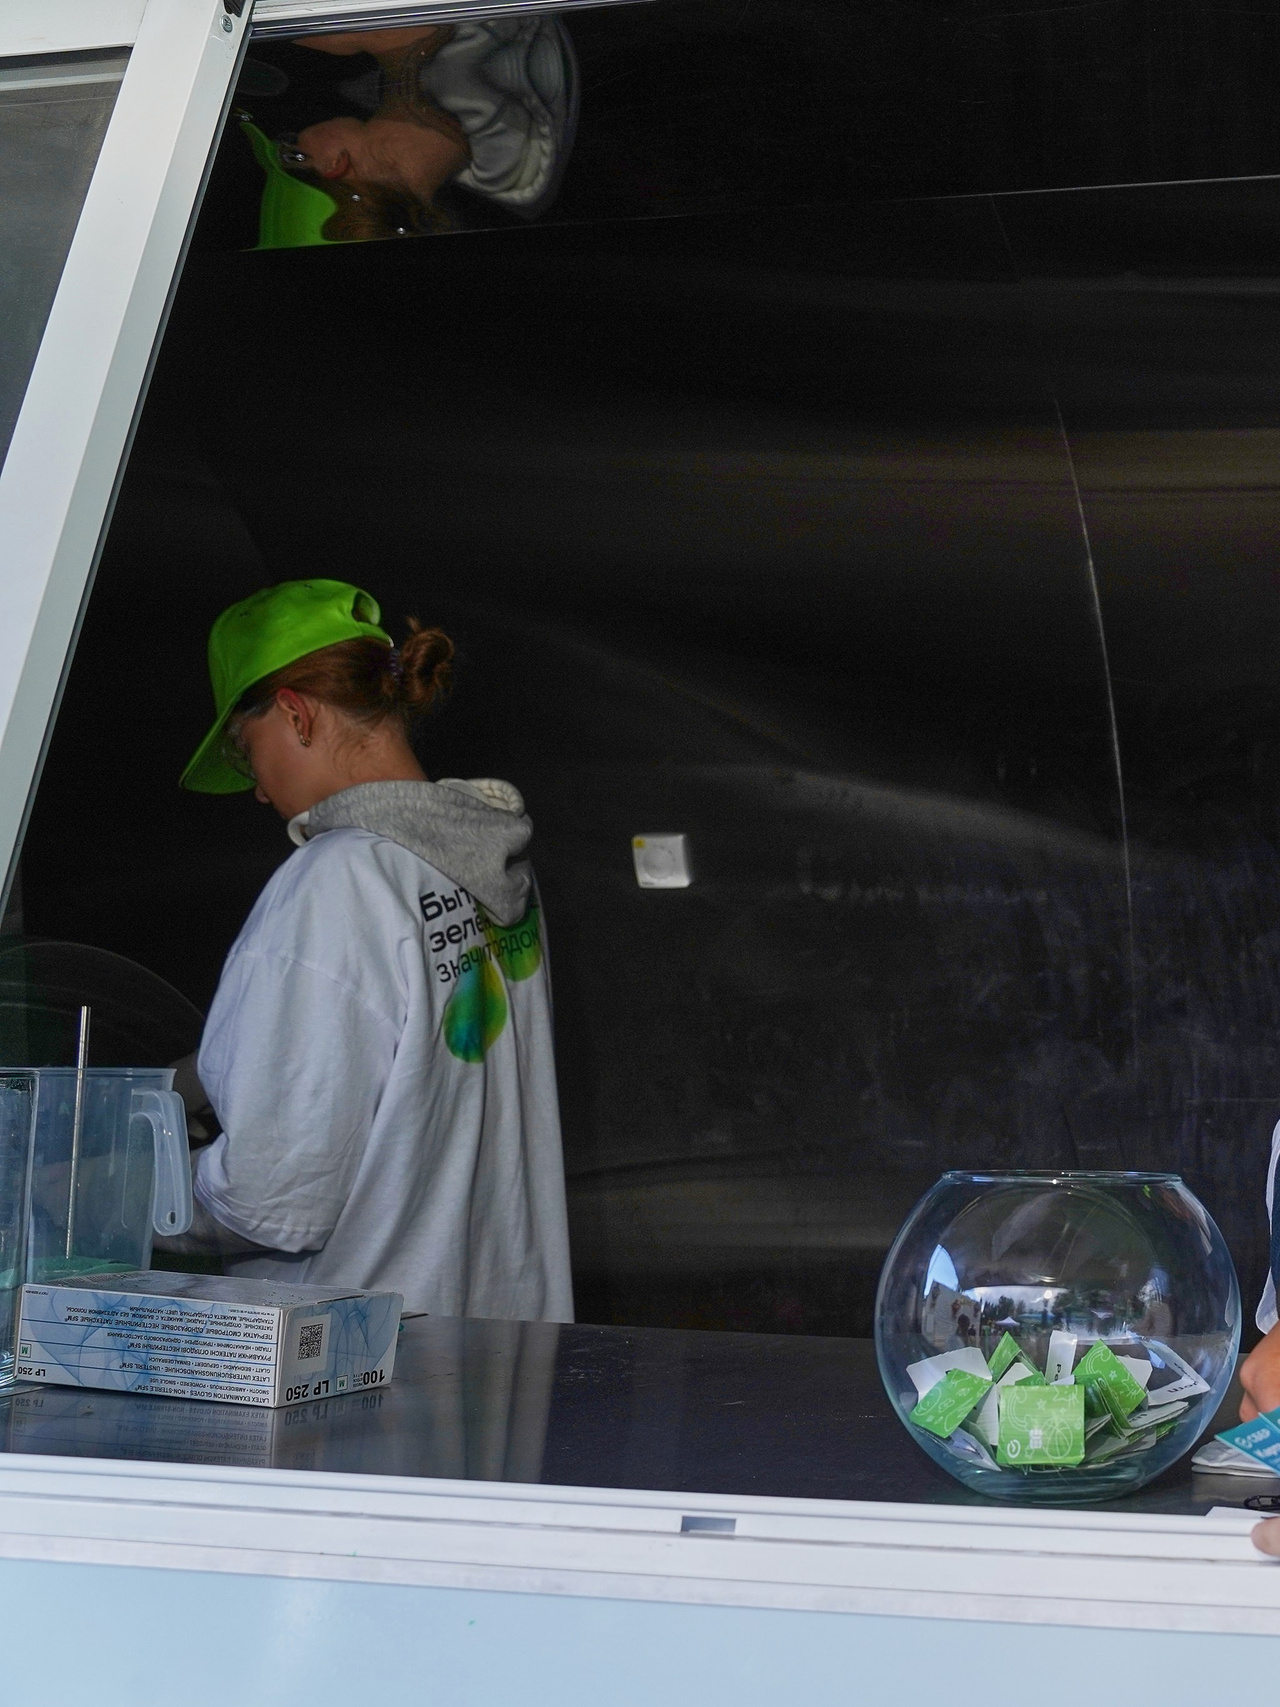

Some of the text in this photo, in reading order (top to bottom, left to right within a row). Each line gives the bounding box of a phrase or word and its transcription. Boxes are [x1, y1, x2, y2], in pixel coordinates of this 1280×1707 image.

[420, 887, 472, 922] Быт
[79, 1315, 113, 1325] ЛАТЕКСНЫЕ
[114, 1318, 159, 1330] НЕСТЕРИЛЬНЫЕ
[160, 1322, 203, 1333] ОДНОРАЗОВЫЕ
[205, 1327, 241, 1337] СМОТРОВЫЕ
[242, 1331, 272, 1340] ПЕРЧАТКИ
[141, 1342, 180, 1353] НЕСТЕРИЛЬНІ
[209, 1349, 237, 1358] ЛАТЕКСНІ
[237, 1352, 271, 1362] РУКАВИЧКИ
[133, 1362, 160, 1372] UNSTERIL
[194, 1360, 219, 1369] GEPUDERT
[17, 1366, 45, 1376] LP 250
[164, 1365, 251, 1381] UNTERSUCHUNGSHANDSCHUHE
[158, 1377, 176, 1385] SINGLE
[251, 1374, 270, 1383] LATEX
[363, 1369, 385, 1385] 100
[179, 1379, 206, 1388] POWDERED
[209, 1383, 246, 1393] AMBIDEXTROUS
[149, 1384, 185, 1395] NON-STERILE
[189, 1389, 212, 1398] GLOVES
[248, 1387, 269, 1395] SMOOTH
[286, 1380, 329, 1401] LP 250
[213, 1391, 250, 1402] EXAMINATION
[251, 1396, 269, 1404] LATEX
